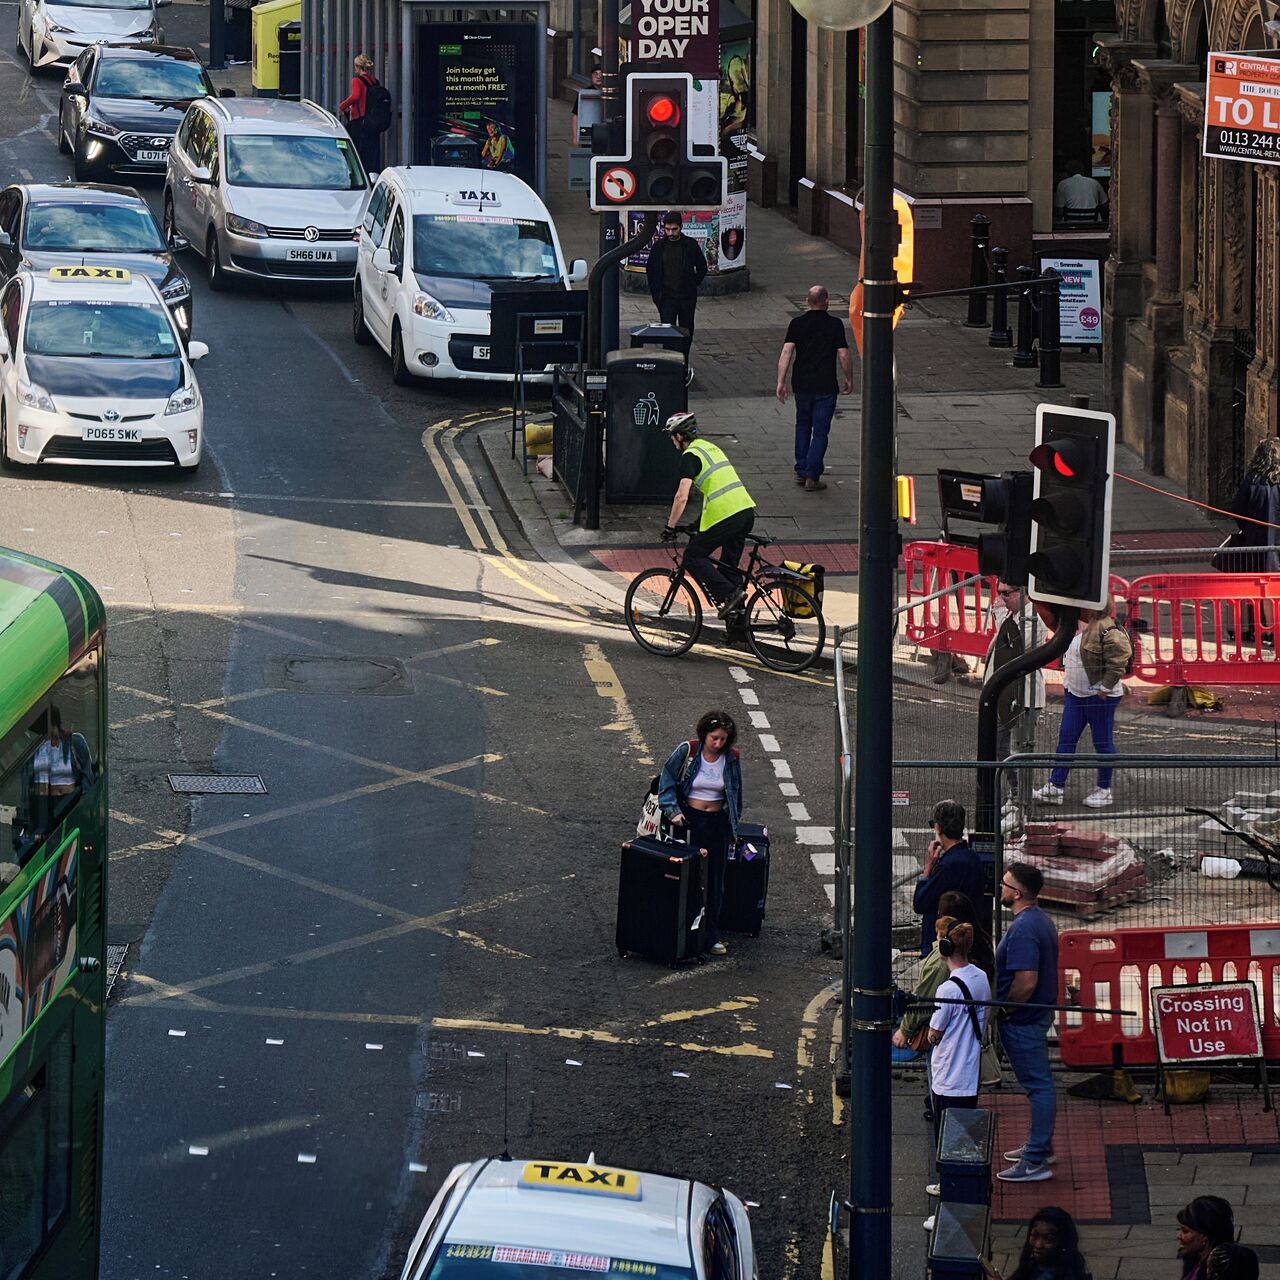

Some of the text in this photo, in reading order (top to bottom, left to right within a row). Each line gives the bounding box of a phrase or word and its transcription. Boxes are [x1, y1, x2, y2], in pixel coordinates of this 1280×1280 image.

[637, 16, 709, 36] OPEN
[638, 38, 690, 60] DAY
[445, 67, 496, 77] Join today get
[1239, 70, 1268, 80] PROPERTY
[445, 75, 499, 83] this month and
[1214, 95, 1254, 126] TO
[1220, 130, 1249, 146] 0113
[1252, 133, 1273, 149] 244
[141, 150, 161, 161] LO71
[459, 190, 496, 201] TAXI
[606, 228, 615, 236] 21
[289, 250, 333, 261] SH66 UWA
[56, 267, 124, 279] TAXI
[1080, 315, 1099, 324] £49
[87, 428, 138, 440] PO65 SWK
[1160, 995, 1244, 1013] Crossing
[1176, 1016, 1233, 1034] Not in
[1189, 1038, 1226, 1054] Use
[532, 1163, 626, 1188] TAXI
